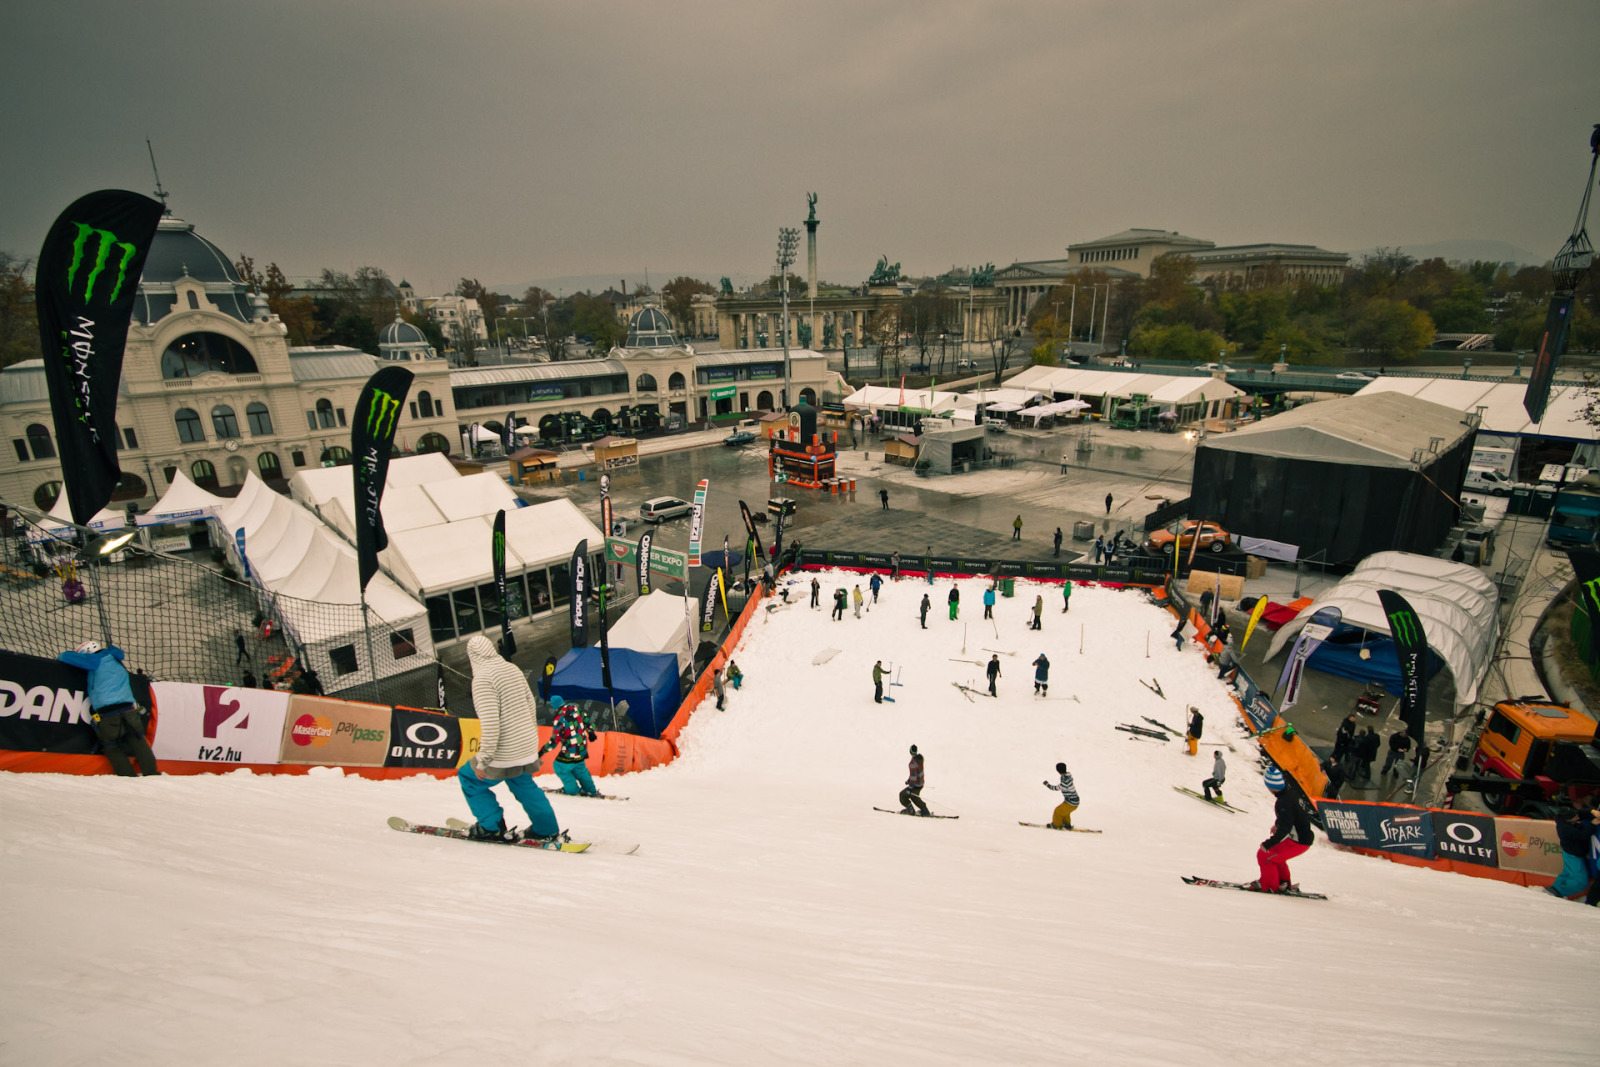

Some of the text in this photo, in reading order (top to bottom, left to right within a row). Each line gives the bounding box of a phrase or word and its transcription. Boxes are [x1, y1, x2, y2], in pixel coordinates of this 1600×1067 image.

[641, 534, 651, 585] FUNDANGO
[661, 554, 683, 567] EXPO
[705, 573, 719, 622] FUNDANGO
[293, 724, 332, 737] MasterCard
[335, 721, 385, 743] pay pass
[198, 745, 242, 762] tv2.hu
[391, 745, 456, 759] OAKLEY
[1327, 818, 1360, 830] ITTHON?
[1440, 841, 1493, 859] OAKLEY
[1529, 836, 1563, 856] pay pa
